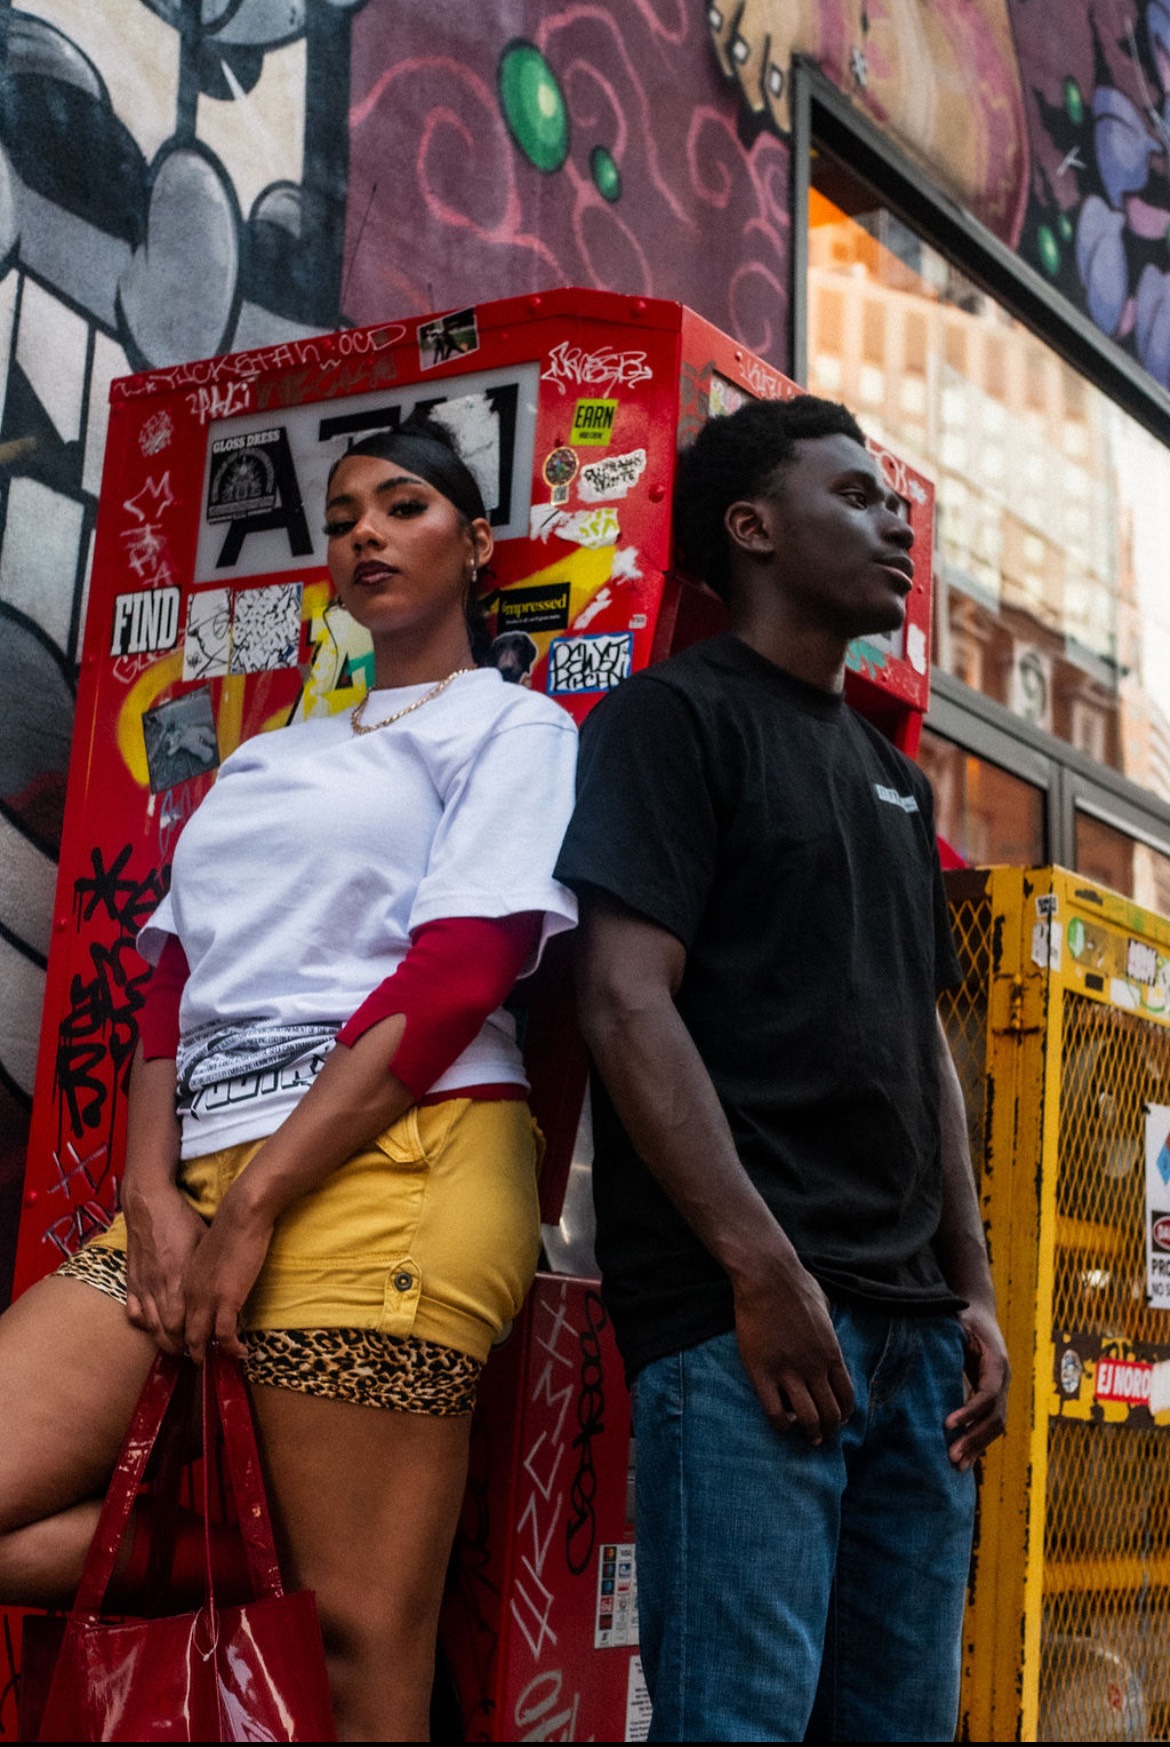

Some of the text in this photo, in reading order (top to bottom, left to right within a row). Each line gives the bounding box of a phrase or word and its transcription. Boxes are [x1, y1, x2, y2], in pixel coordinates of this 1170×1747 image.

[575, 406, 615, 429] EARN
[213, 430, 280, 454] GLOSS DRESS
[111, 587, 180, 657] FIND
[1097, 1363, 1114, 1395] EJ
